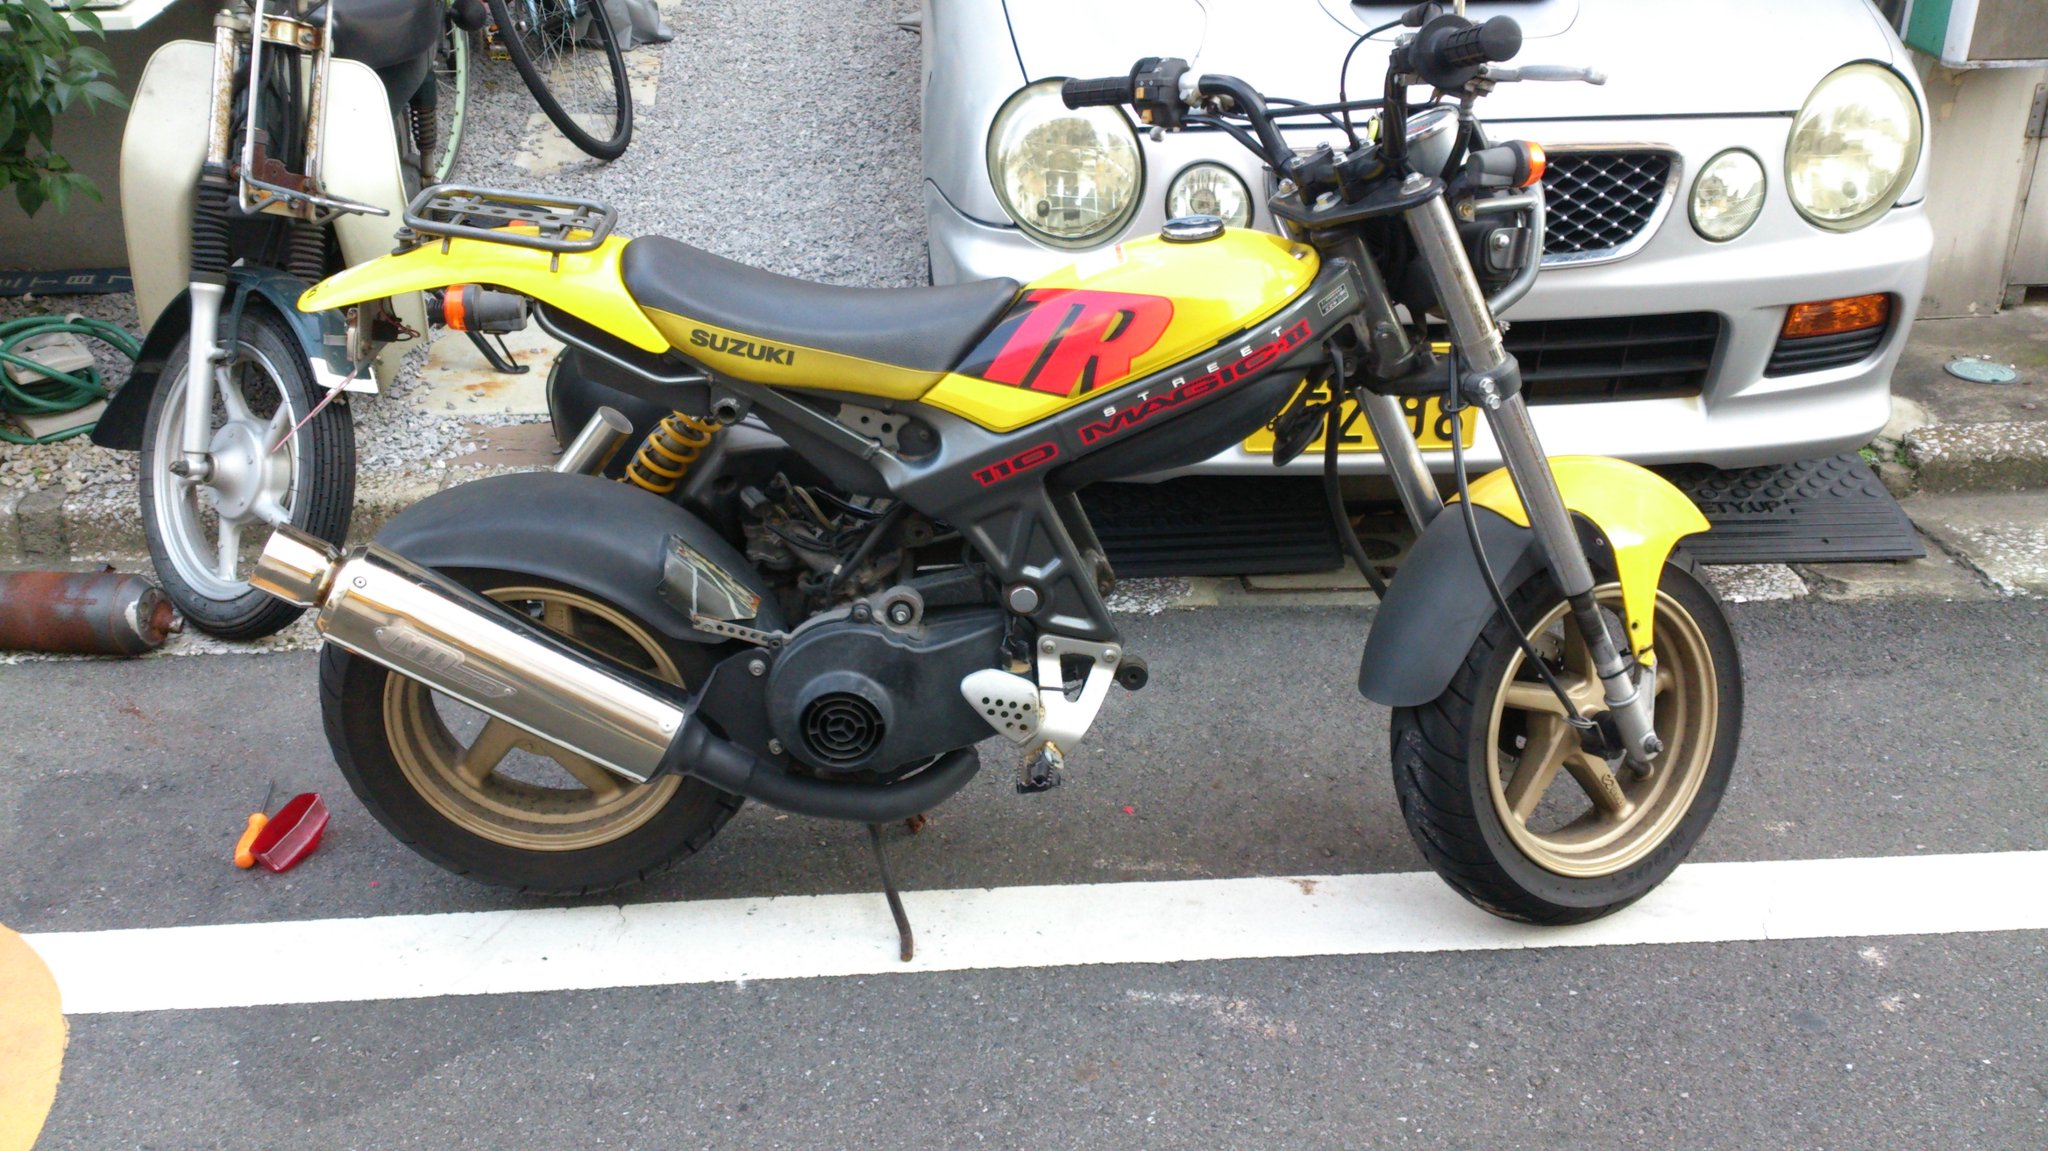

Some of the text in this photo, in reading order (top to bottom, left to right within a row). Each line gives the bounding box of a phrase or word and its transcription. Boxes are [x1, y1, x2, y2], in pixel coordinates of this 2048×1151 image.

[690, 328, 795, 366] SUZUKI
[1103, 326, 1282, 417] STREET
[971, 442, 1059, 487] 110
